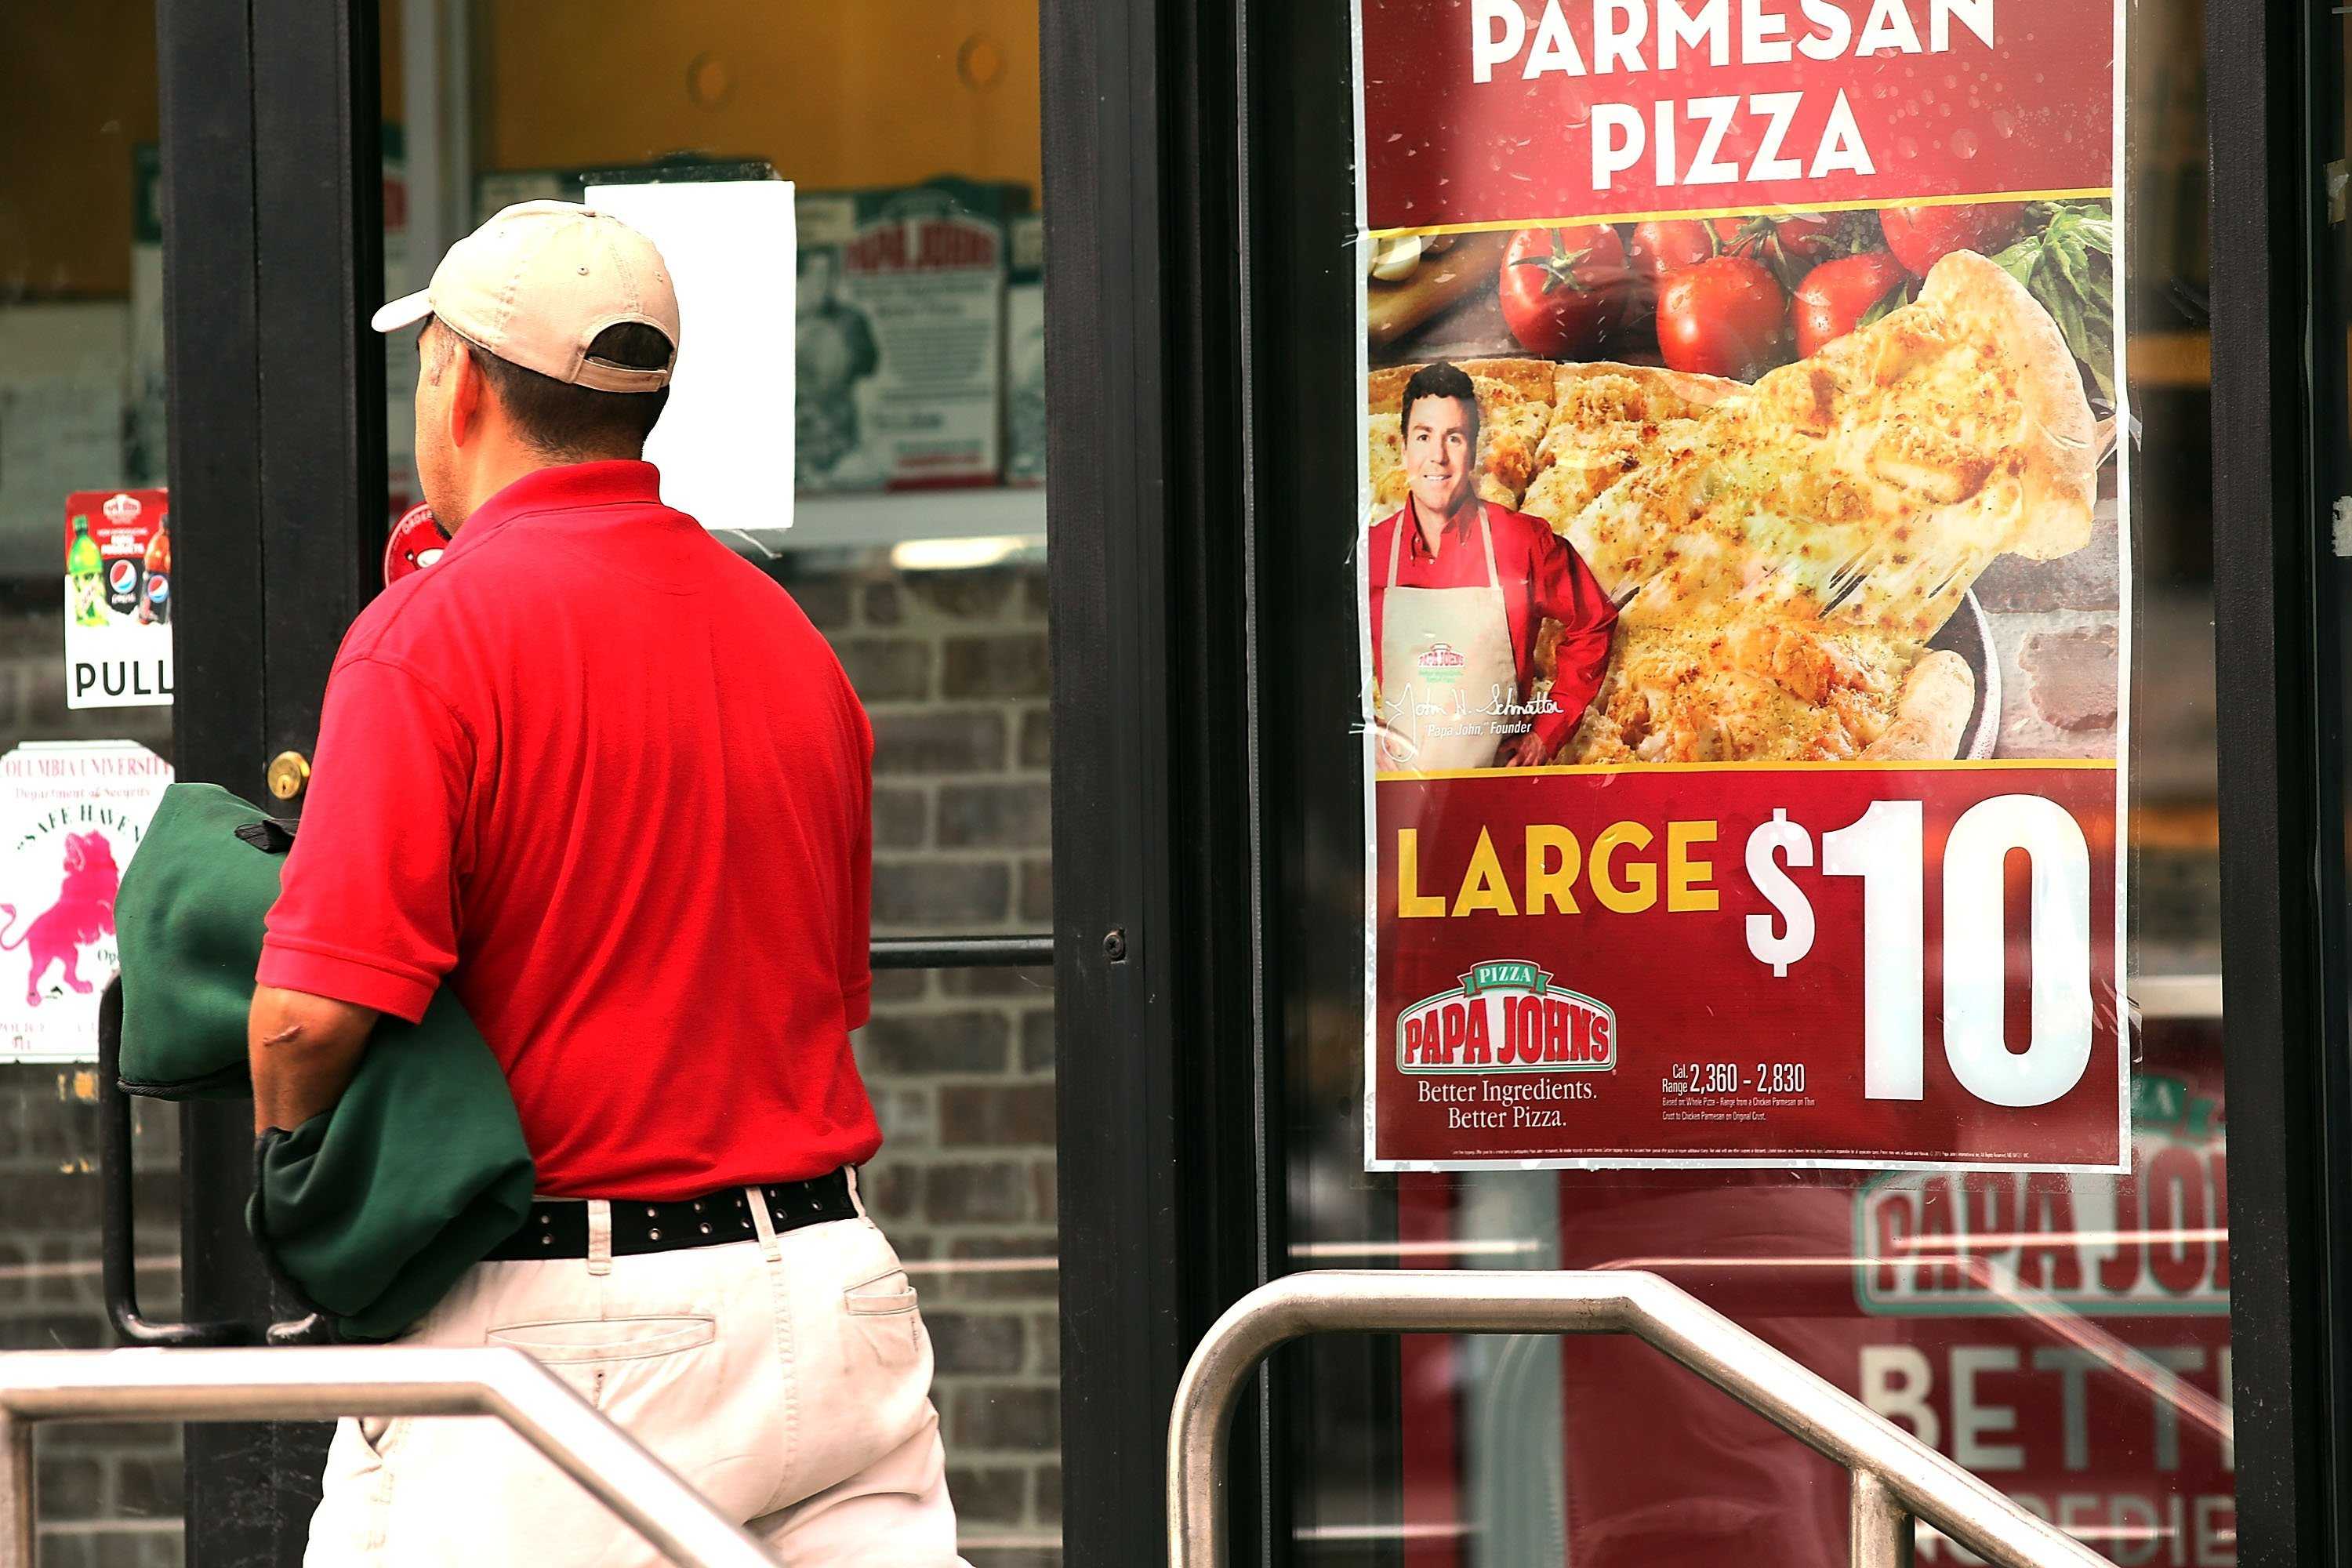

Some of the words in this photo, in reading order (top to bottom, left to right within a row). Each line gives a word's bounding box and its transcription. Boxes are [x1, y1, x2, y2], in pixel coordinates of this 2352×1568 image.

[1471, 0, 1994, 83] PARMESAN
[1590, 87, 1876, 191] PIZZA
[75, 660, 175, 697] PULL
[1490, 720, 1532, 735] Founder
[5, 758, 77, 778] OLUMBIA
[1398, 820, 1719, 918] LARGE
[1745, 793, 2094, 1107] $10
[1479, 966, 1531, 983] PIZZA
[1404, 998, 1492, 1064] PAPA
[1497, 996, 1610, 1064] JOHN'S
[1662, 1078, 1688, 1096] Range
[1690, 1063, 1737, 1094] 2,360
[1757, 1063, 1805, 1094] 2,830
[1672, 1063, 1689, 1079] Cal.
[1417, 1080, 1477, 1103] Better
[1482, 1078, 1598, 1106] Ingredients.
[1447, 1107, 1507, 1129] Better
[1512, 1105, 1567, 1128] Pizza.
[1875, 1174, 2082, 1294] PAPA
[2096, 1145, 2229, 1298] JO
[1859, 1345, 2234, 1472] BETT
